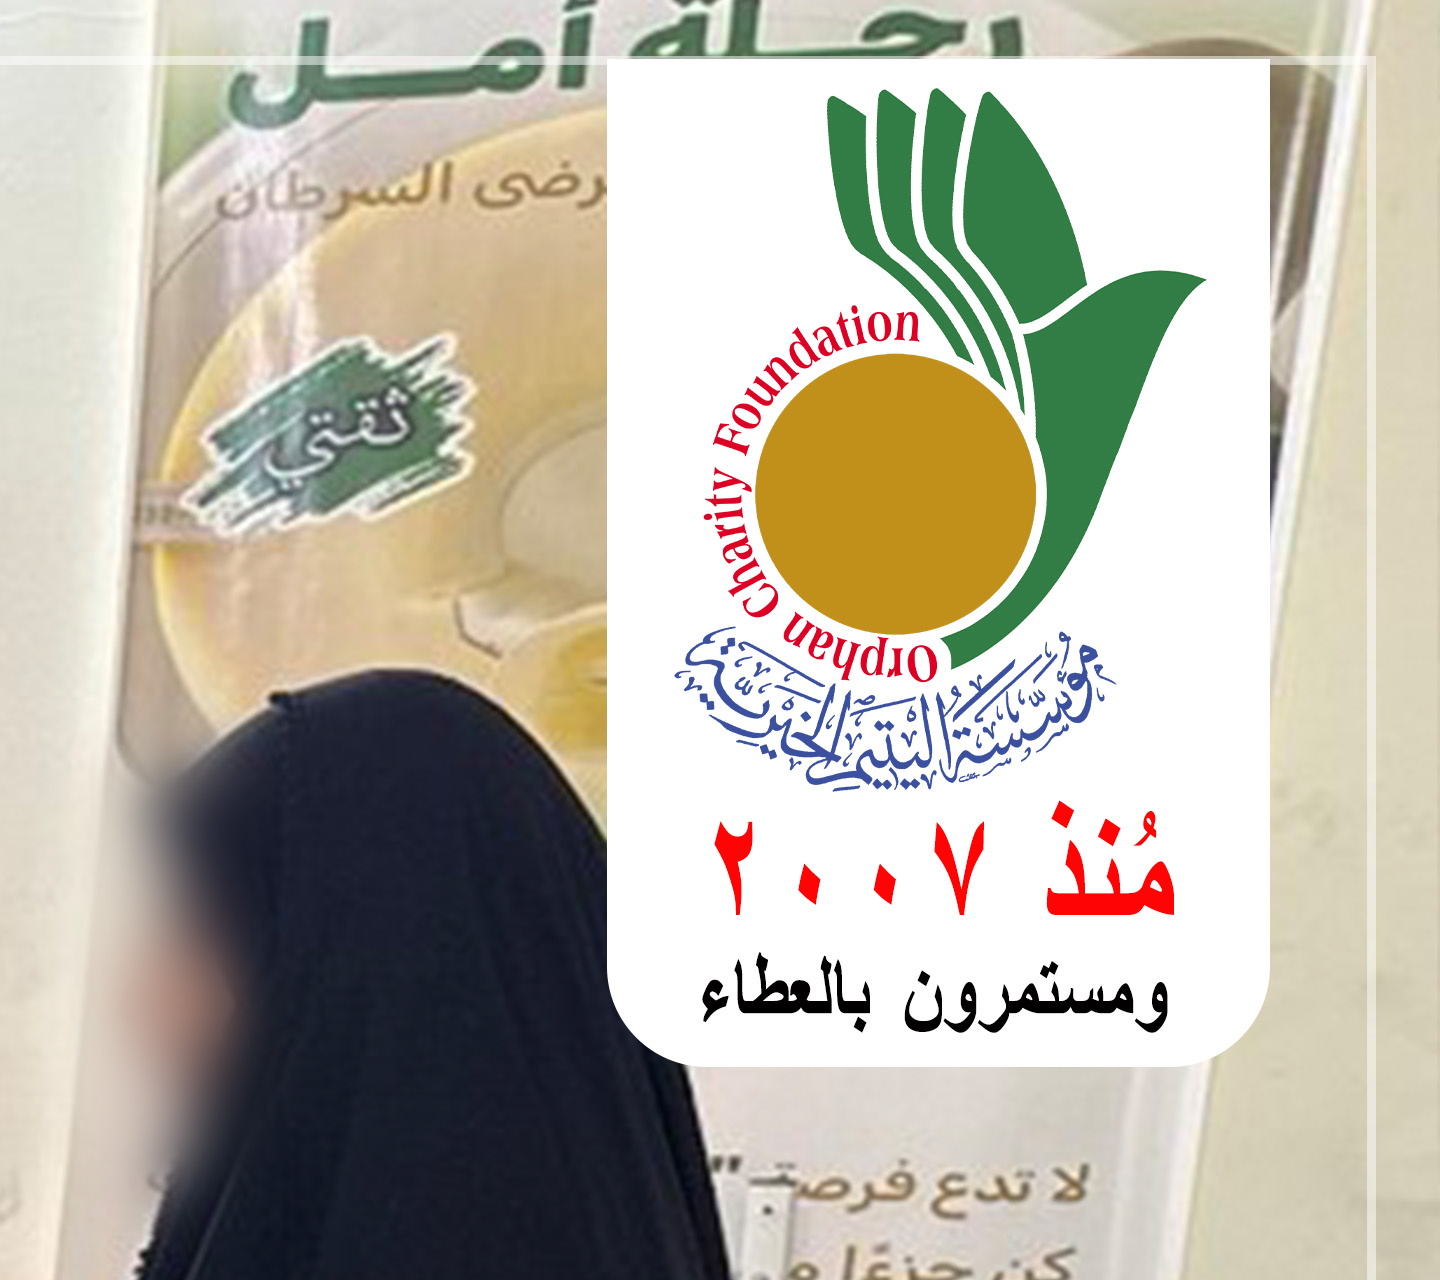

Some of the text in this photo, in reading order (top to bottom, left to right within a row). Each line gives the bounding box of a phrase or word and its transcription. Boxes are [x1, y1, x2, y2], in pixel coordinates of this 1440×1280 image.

[227, 0, 597, 130] أمل
[216, 158, 607, 222] رضى السرطان
[262, 386, 414, 490] ثقتي
[747, 1157, 1089, 1221] لا تدع فرصت
